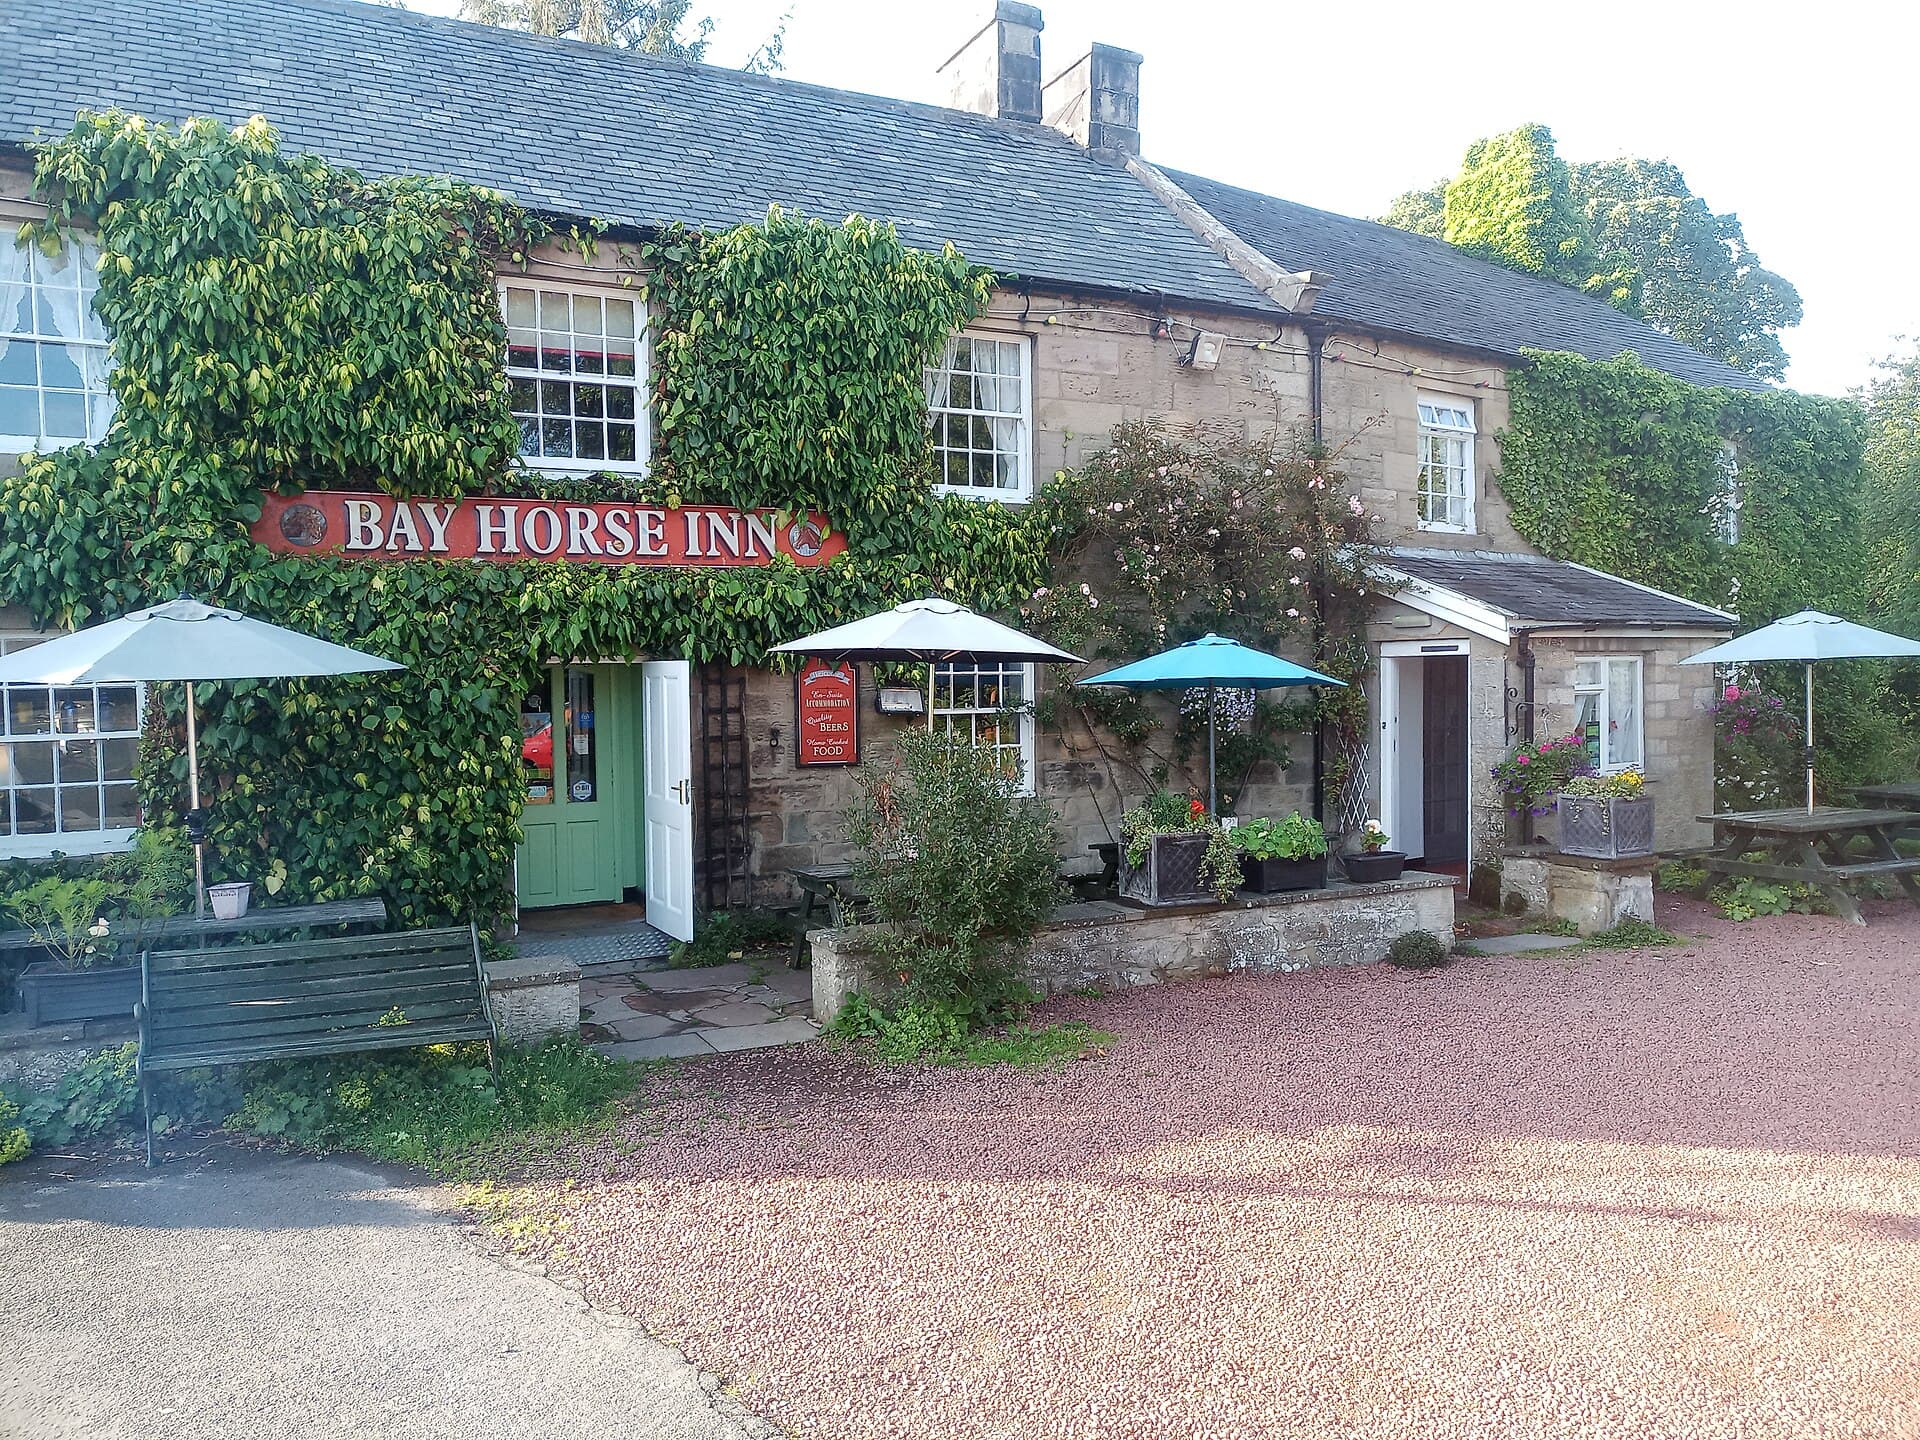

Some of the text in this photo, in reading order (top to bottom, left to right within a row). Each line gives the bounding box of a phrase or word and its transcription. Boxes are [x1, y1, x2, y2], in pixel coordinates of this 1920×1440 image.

[344, 500, 778, 558] BAY HORSE INN
[805, 713, 832, 726] Quality
[820, 721, 849, 732] BEERS
[813, 746, 843, 756] FOOD
